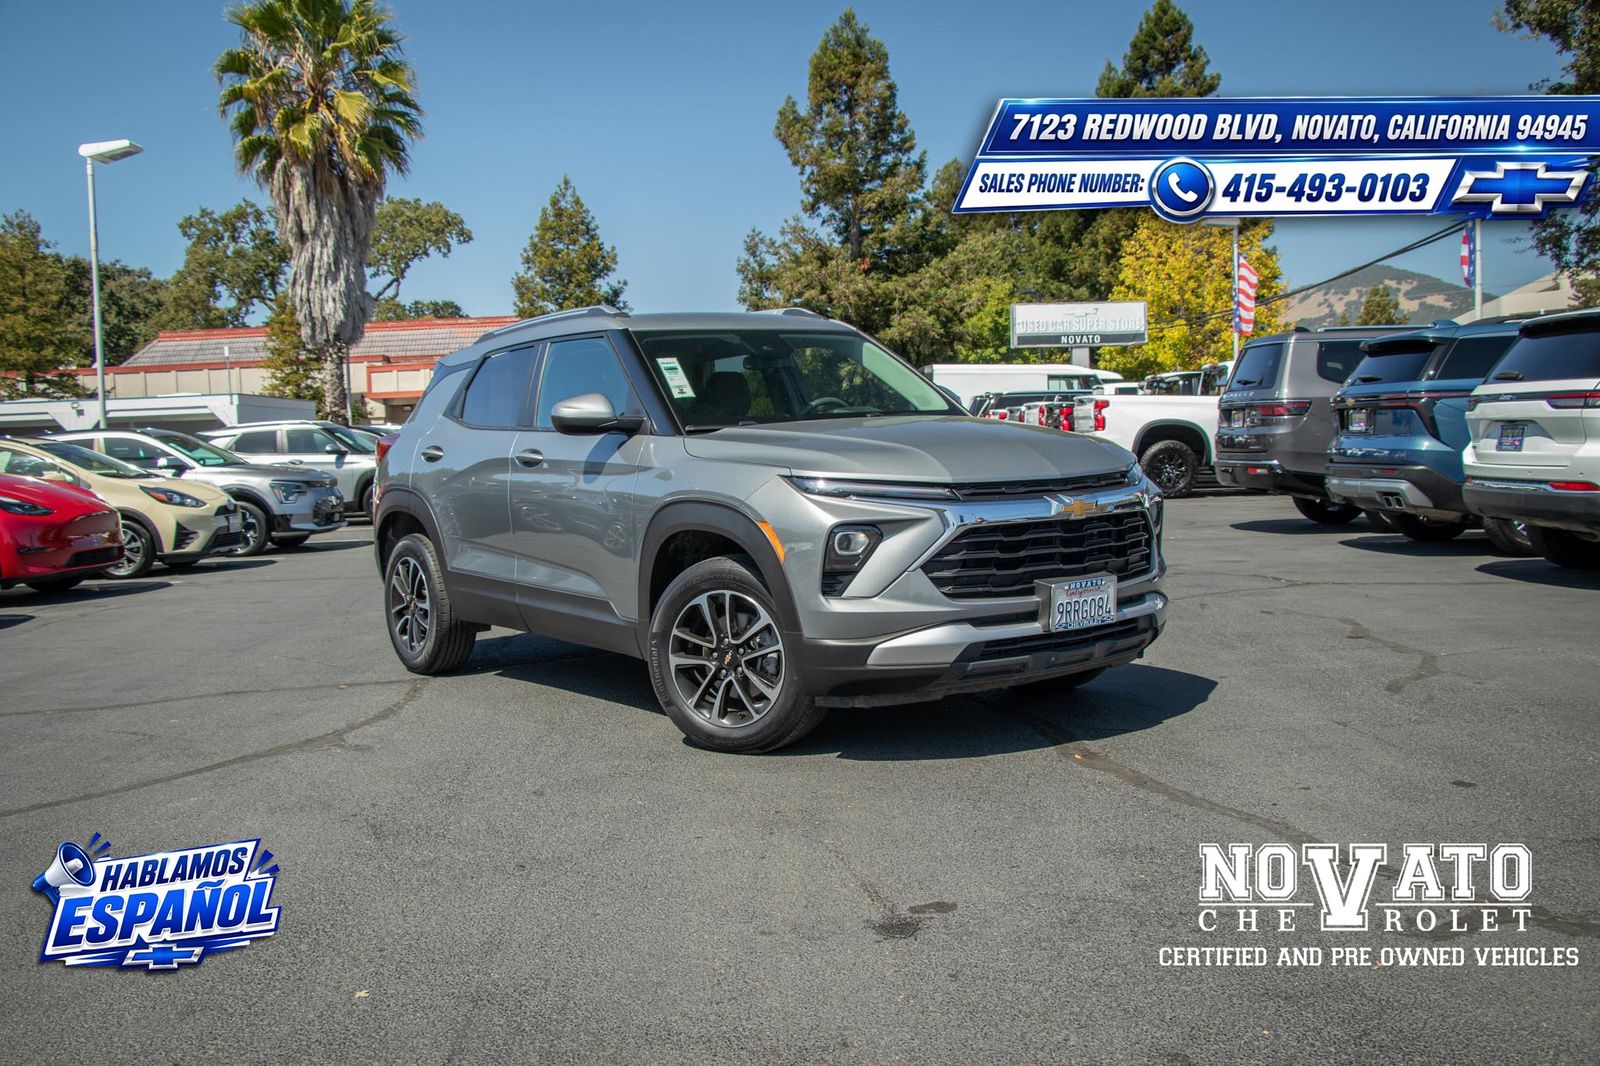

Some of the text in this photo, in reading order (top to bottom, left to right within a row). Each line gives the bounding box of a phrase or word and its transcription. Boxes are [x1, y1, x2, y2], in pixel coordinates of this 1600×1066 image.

[1049, 319, 1071, 331] CAR
[1072, 318, 1106, 331] SUPER
[1108, 317, 1143, 330] STORE
[1061, 335, 1100, 344] NOVATO
[1070, 580, 1102, 589] NOVATO
[1055, 595, 1111, 626] 9RRG084
